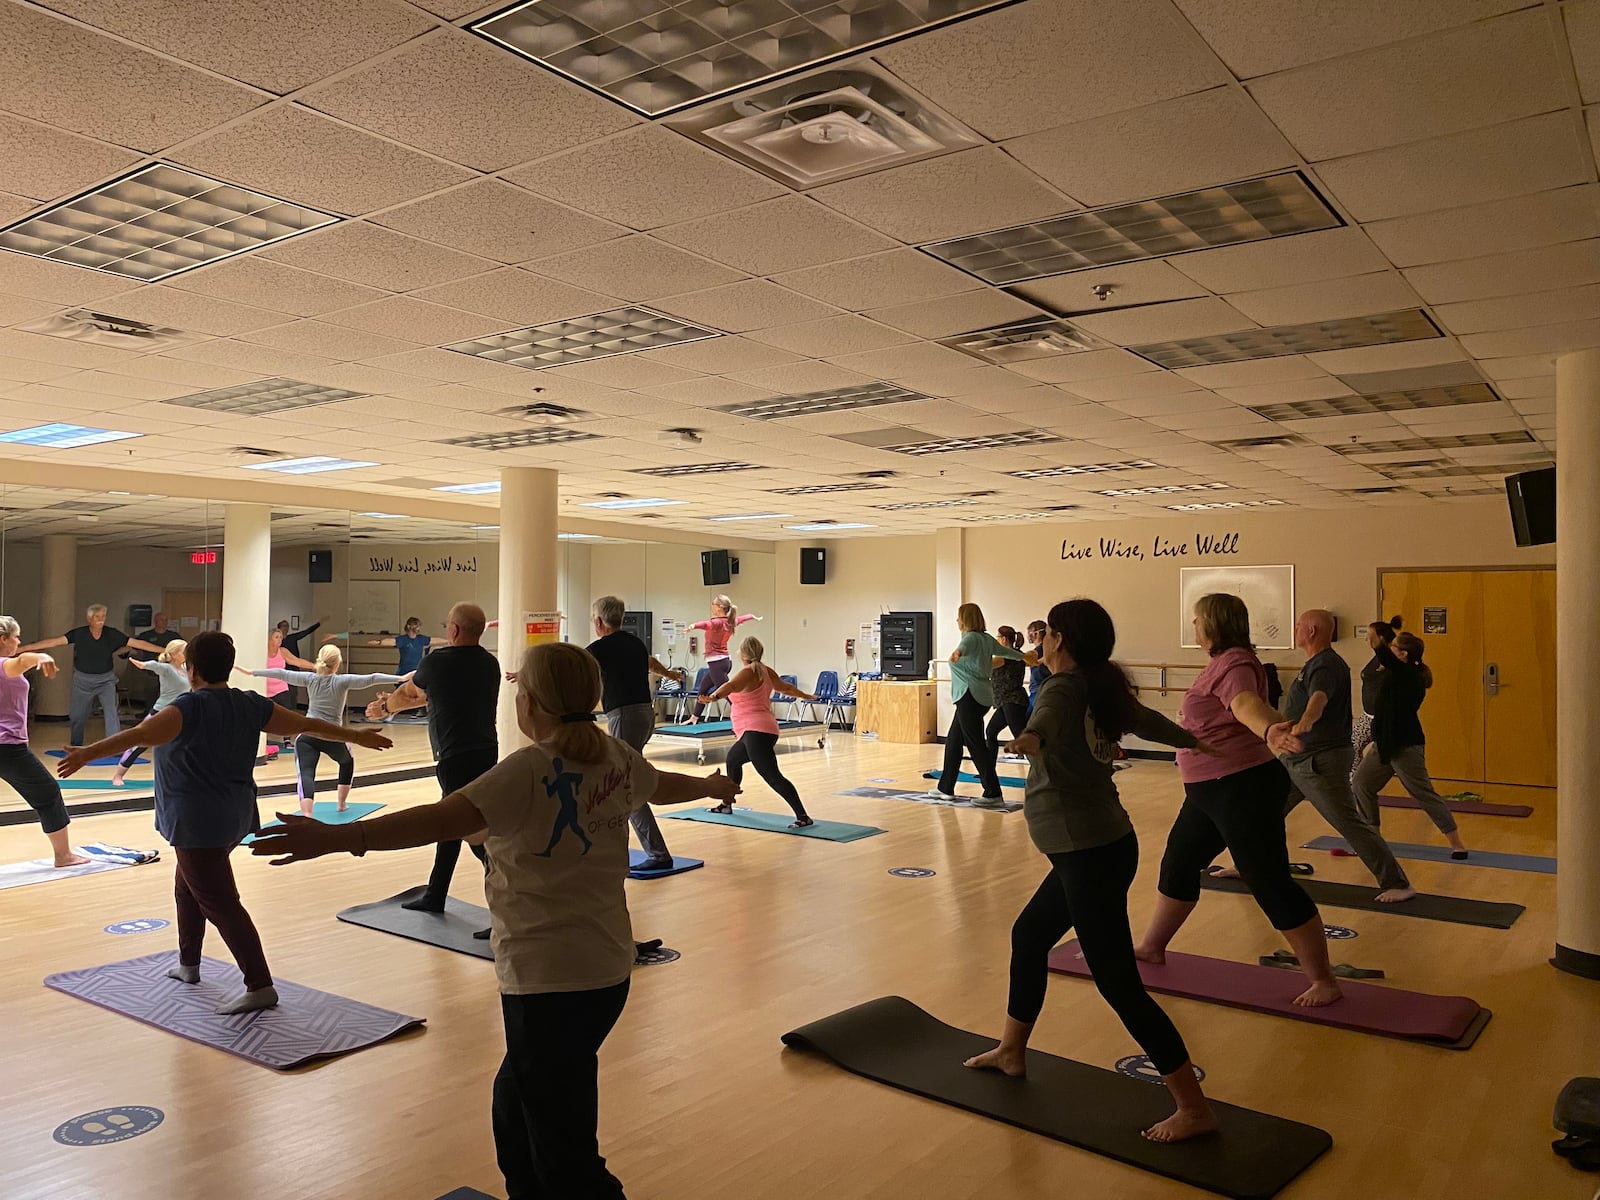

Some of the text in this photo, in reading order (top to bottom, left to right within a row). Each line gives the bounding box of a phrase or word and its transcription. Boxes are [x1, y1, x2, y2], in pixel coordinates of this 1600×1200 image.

[1061, 532, 1239, 561] Live Wise, Live Well
